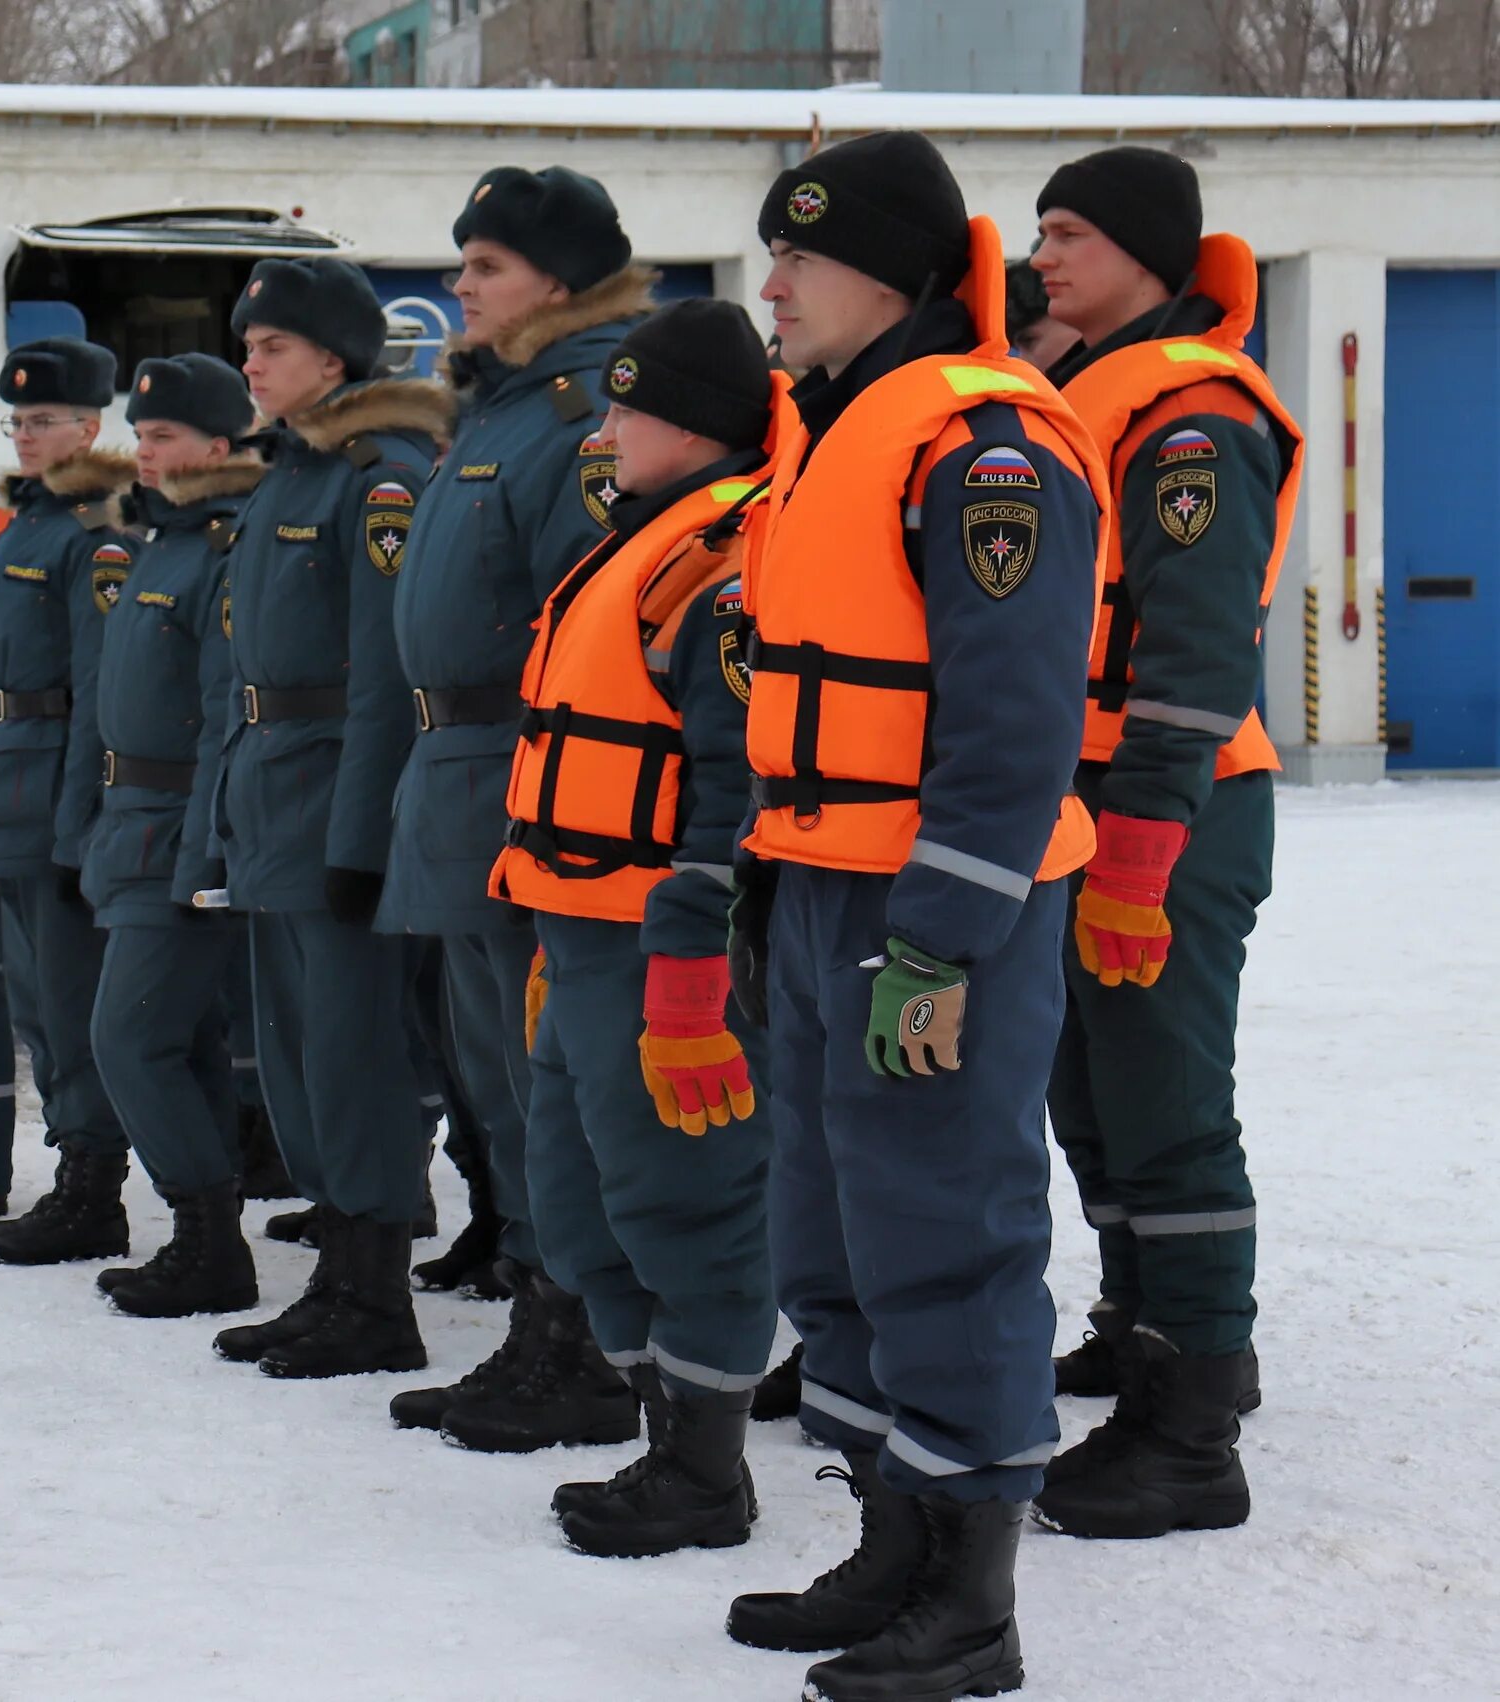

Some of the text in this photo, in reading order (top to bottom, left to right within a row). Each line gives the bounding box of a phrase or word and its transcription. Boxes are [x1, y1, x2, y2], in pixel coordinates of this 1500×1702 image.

[1164, 448, 1204, 461] RUSSIA
[980, 473, 1028, 483] RUSSIA
[970, 506, 1033, 522] МЧС РОССИИ
